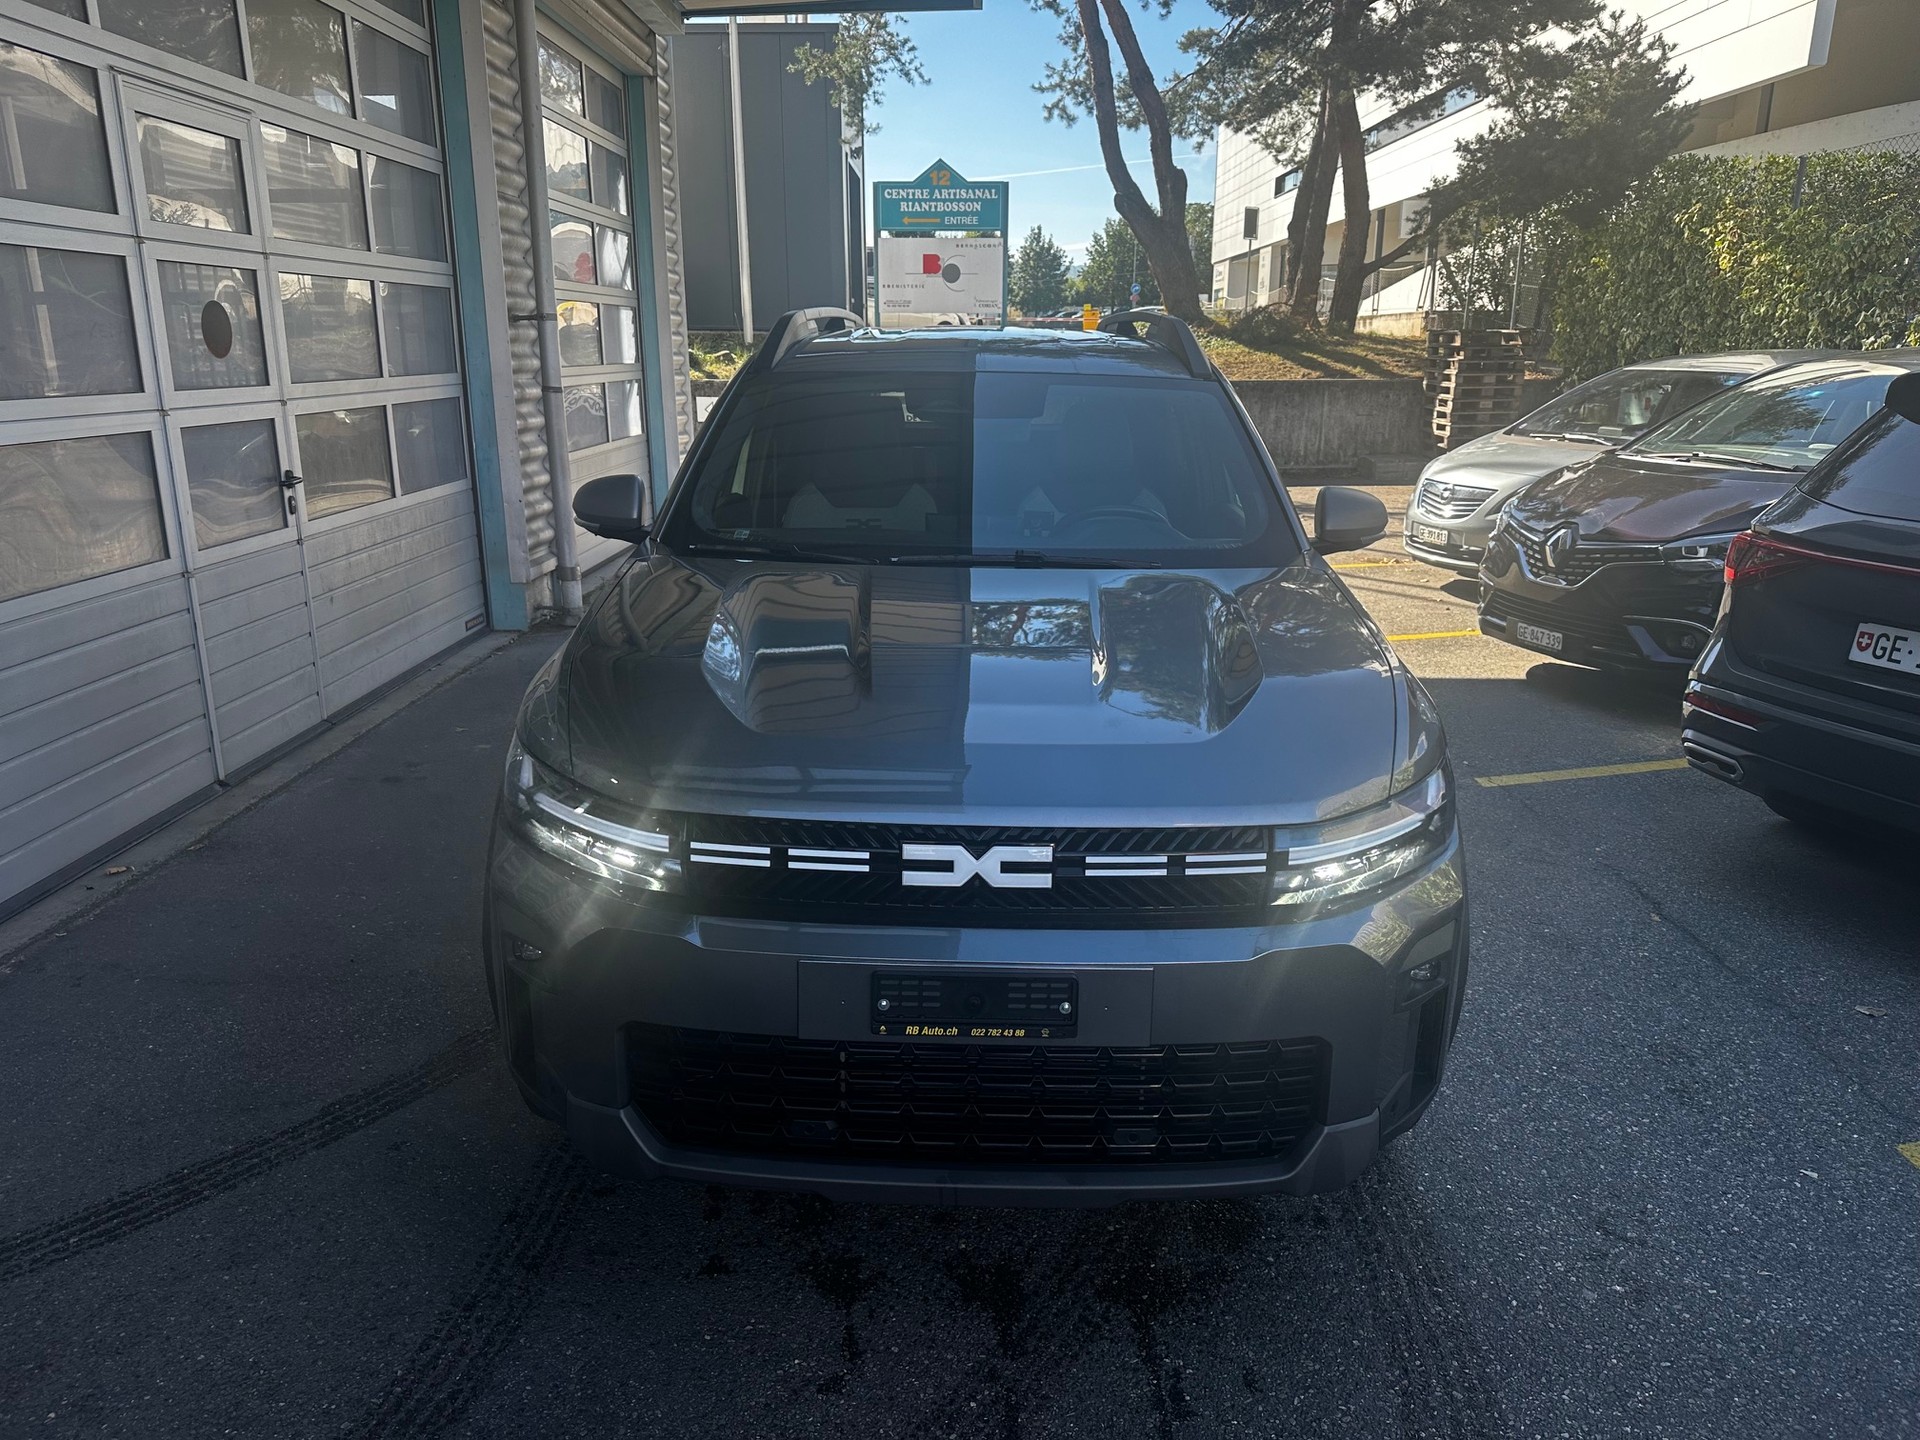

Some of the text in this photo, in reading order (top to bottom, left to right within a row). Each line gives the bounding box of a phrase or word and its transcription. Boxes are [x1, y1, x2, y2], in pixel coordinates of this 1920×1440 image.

[930, 170, 950, 186] 12
[884, 189, 998, 199] CENTRE ARTISANAL
[900, 201, 982, 212] RIANTBOSSON
[944, 215, 979, 225] ENTRÉE
[905, 1026, 958, 1036] RB Auto.ch
[970, 1028, 1025, 1037] 022 782 43 88
